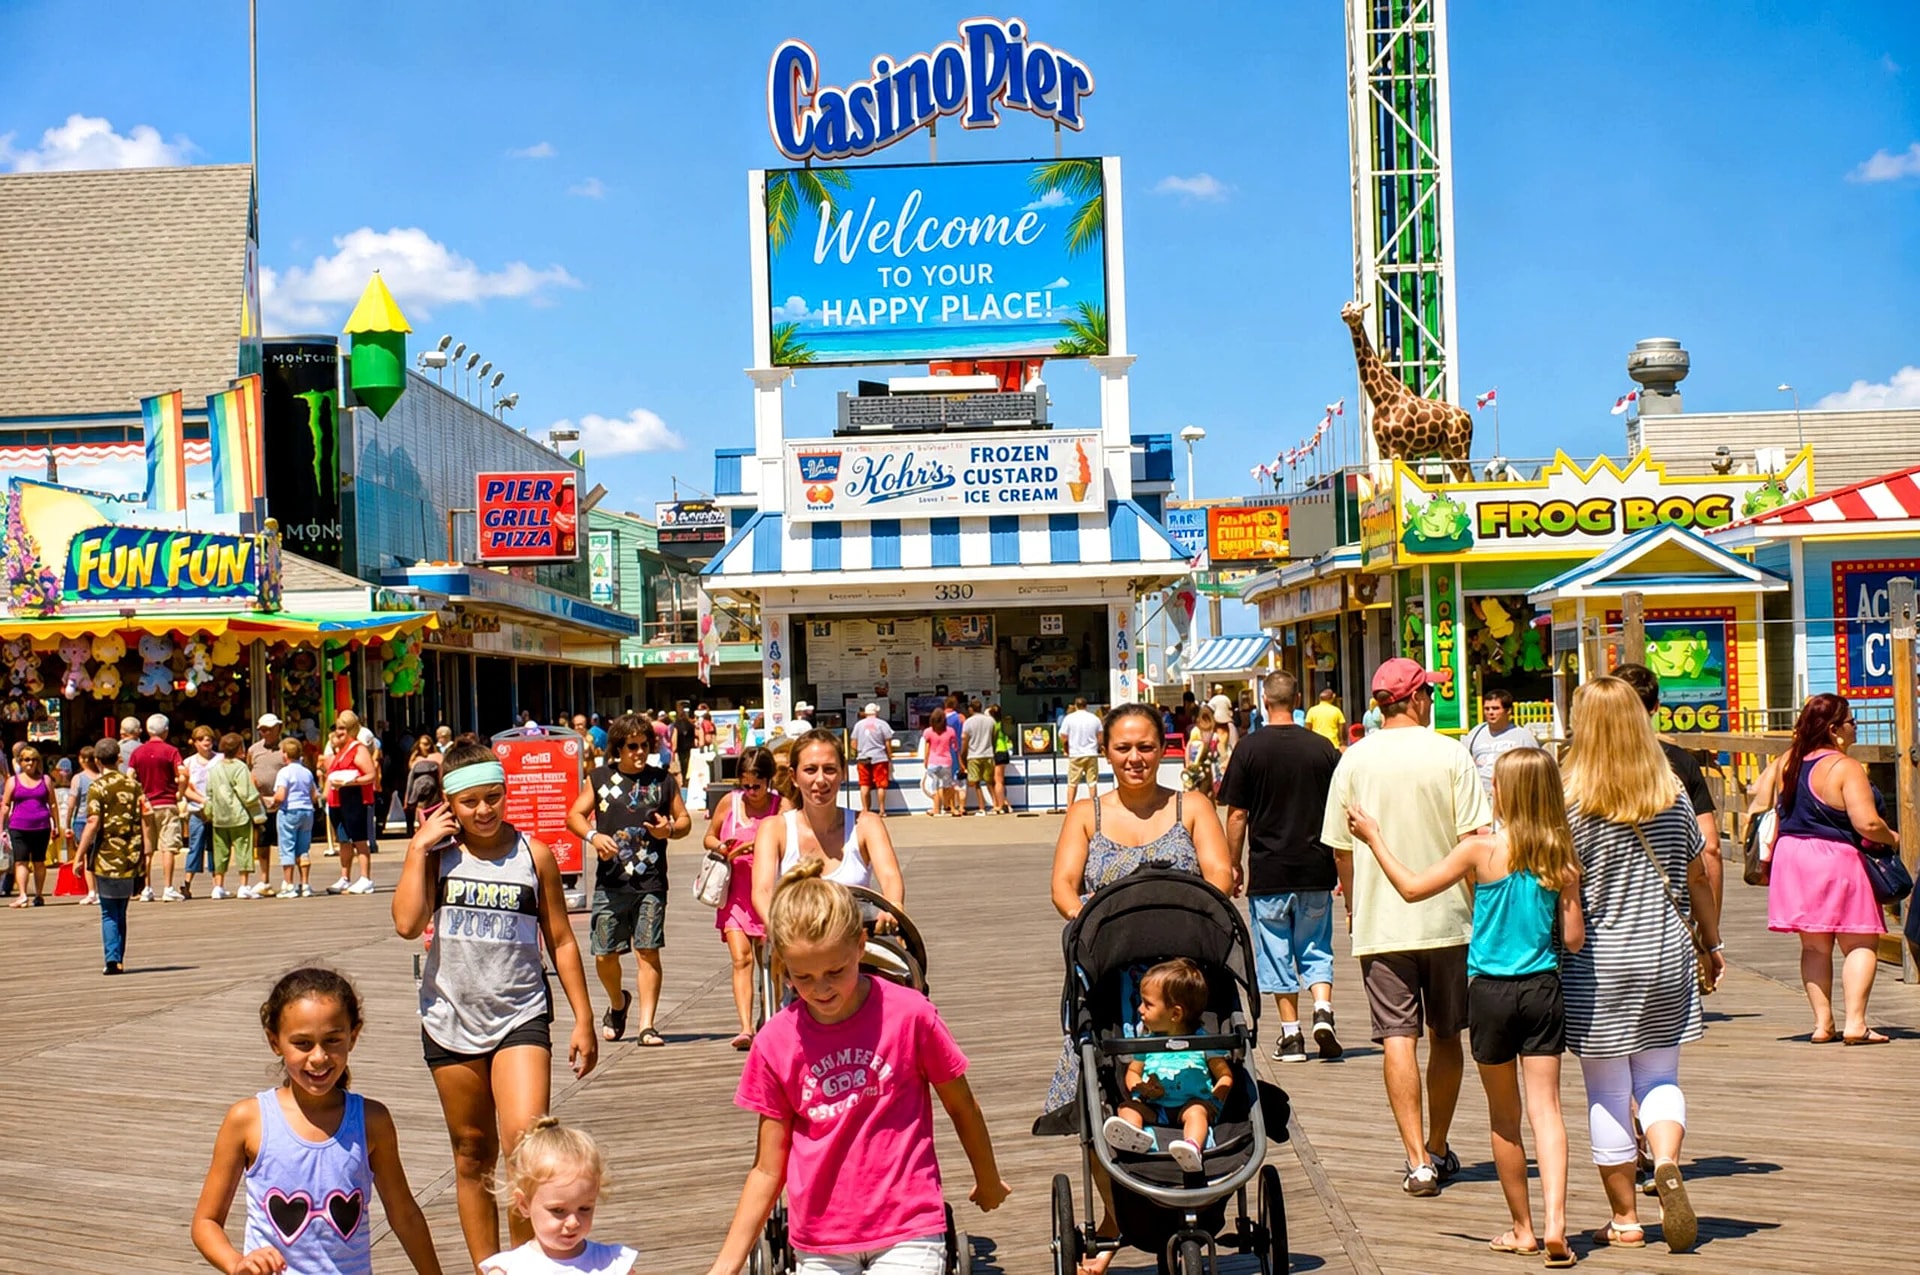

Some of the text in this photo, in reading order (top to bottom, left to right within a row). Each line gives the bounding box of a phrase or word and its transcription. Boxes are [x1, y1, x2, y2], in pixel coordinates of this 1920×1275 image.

[769, 18, 1093, 159] Casino Pier
[814, 188, 1046, 265] Welcome
[878, 263, 994, 288] TO YOUR
[822, 290, 1054, 327] HAPPY PLACE!
[970, 445, 1049, 463] FROZEN
[845, 452, 954, 502] Kohr's
[963, 467, 1058, 485] CUSTARD
[485, 480, 553, 502] PIER
[964, 488, 1058, 503] ICE CREAM
[484, 508, 551, 527] GRILL
[1477, 495, 1734, 538] FROG BOG
[491, 530, 551, 547] PIZZA
[78, 536, 252, 592] FUN FUN
[934, 583, 974, 600] 330
[1655, 704, 1720, 732] BOG
